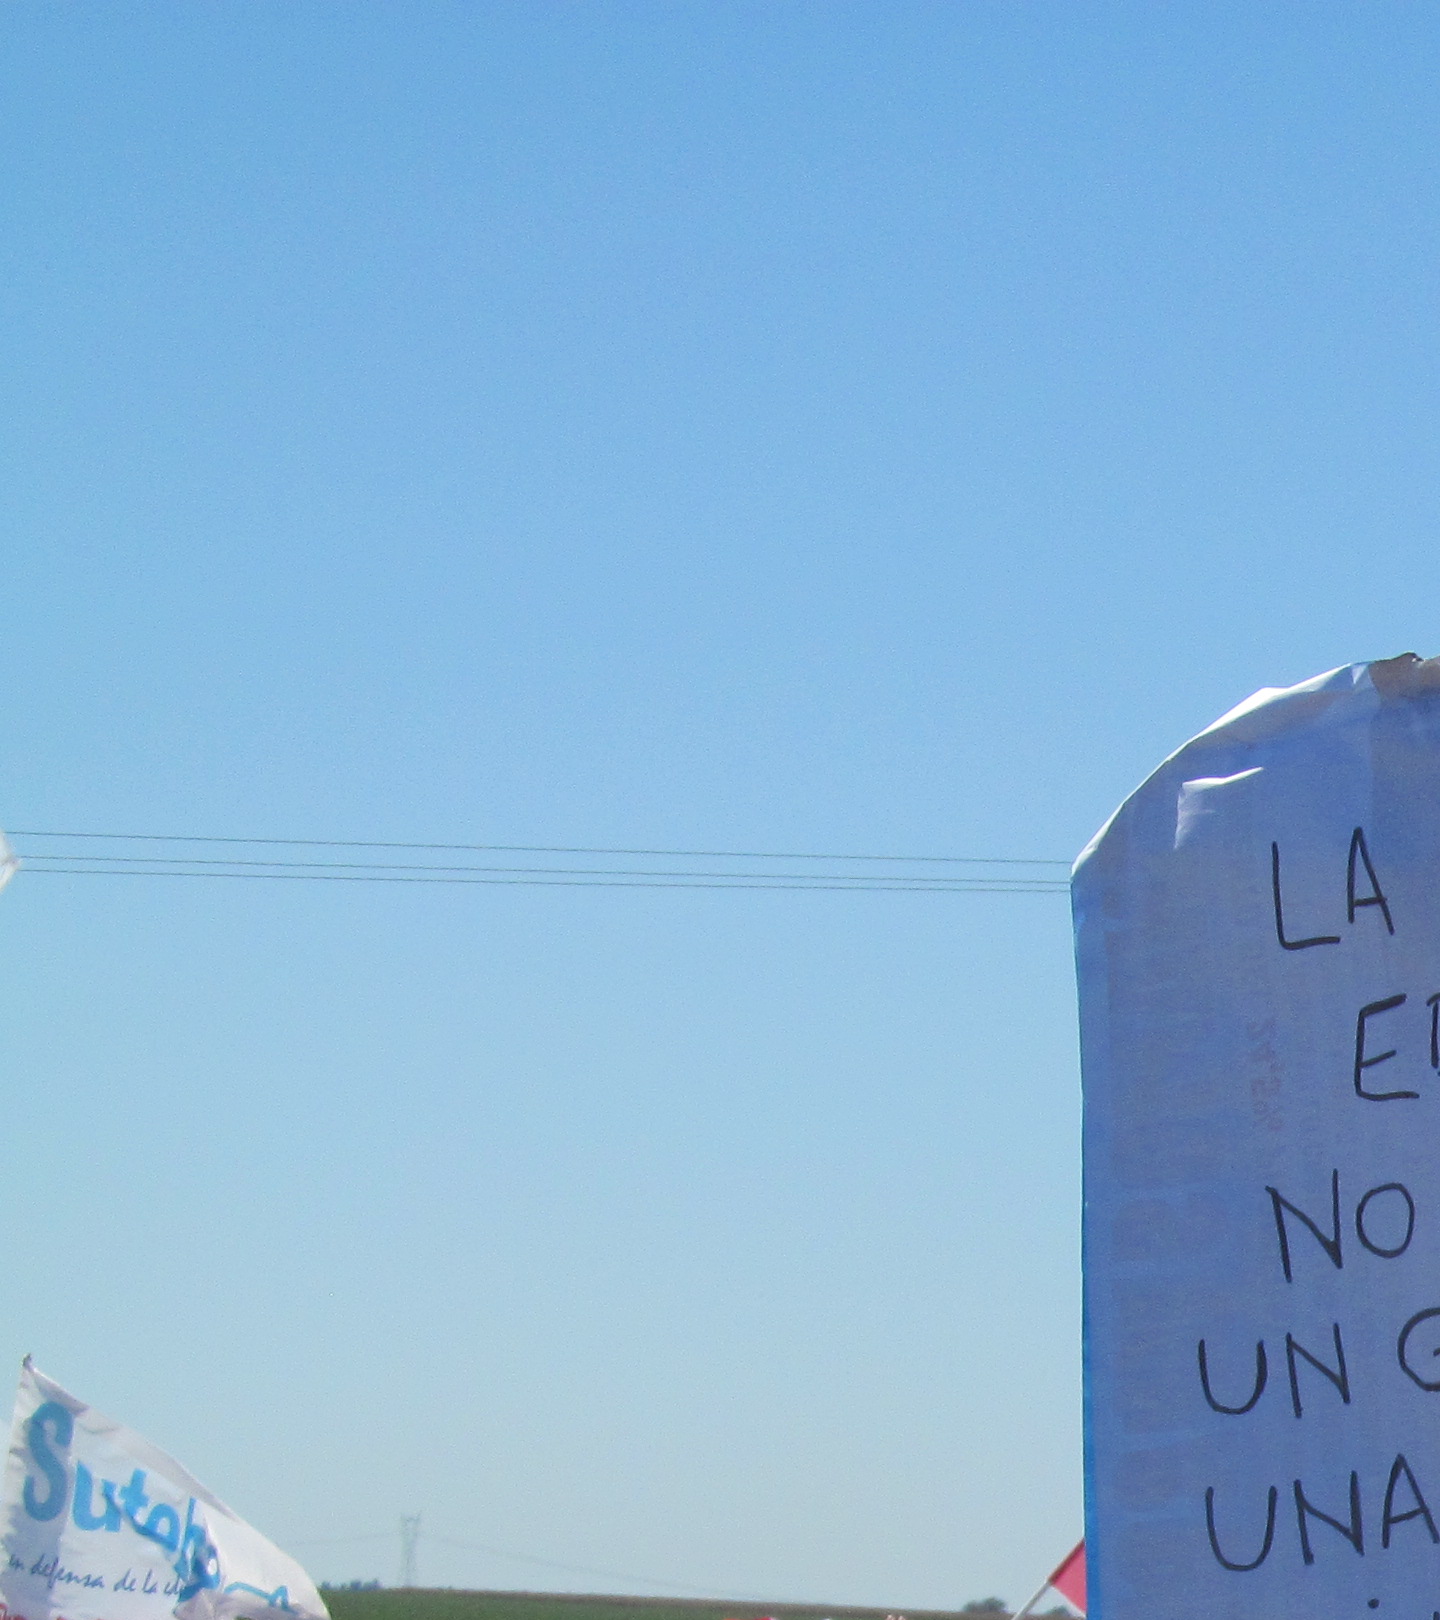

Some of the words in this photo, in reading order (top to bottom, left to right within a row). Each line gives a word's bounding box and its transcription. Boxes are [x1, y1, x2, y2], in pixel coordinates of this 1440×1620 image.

[1272, 826, 1395, 950] LA
[1265, 1168, 1416, 1283] NO
[1198, 1322, 1351, 1419] UN
[1205, 1453, 1440, 1572] UNA
